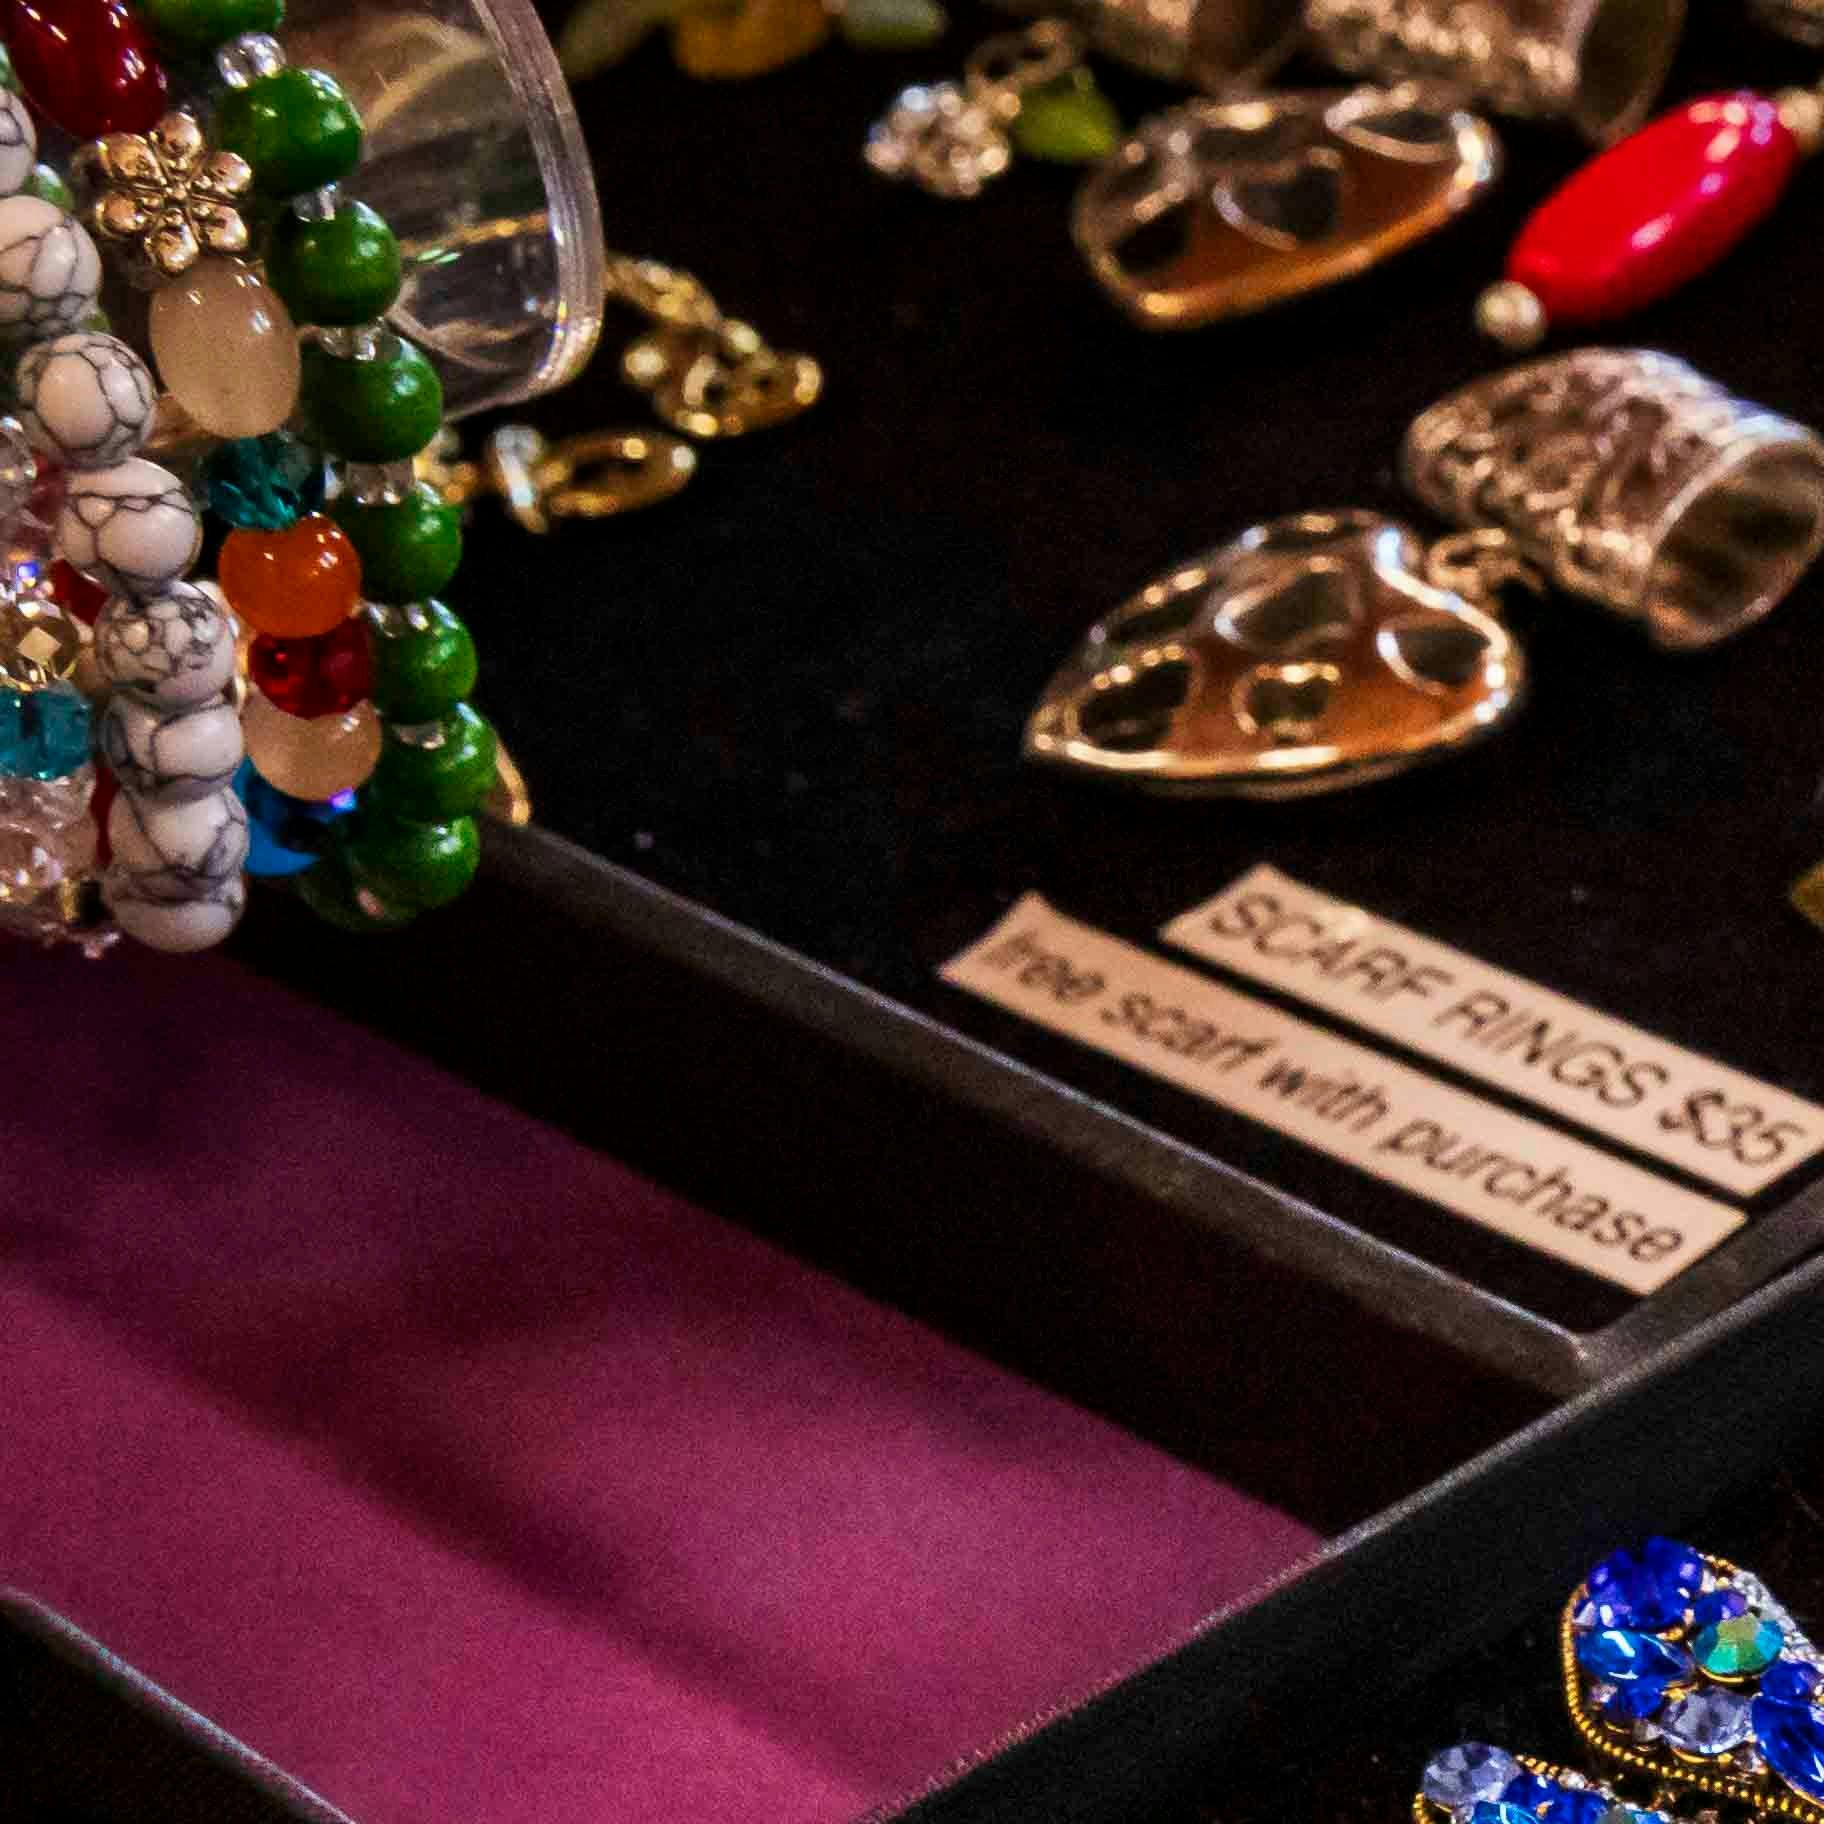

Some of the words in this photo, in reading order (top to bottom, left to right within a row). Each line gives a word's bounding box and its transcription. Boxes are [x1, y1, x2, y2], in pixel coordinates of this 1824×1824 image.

[1100, 993, 1278, 1073] scarf
[1257, 1057, 1391, 1133] with
[1370, 1117, 1685, 1263] purchase
[1209, 893, 1455, 1000] SCARF
[1432, 990, 1670, 1107] RINGS
[1656, 1088, 1806, 1167] $35
